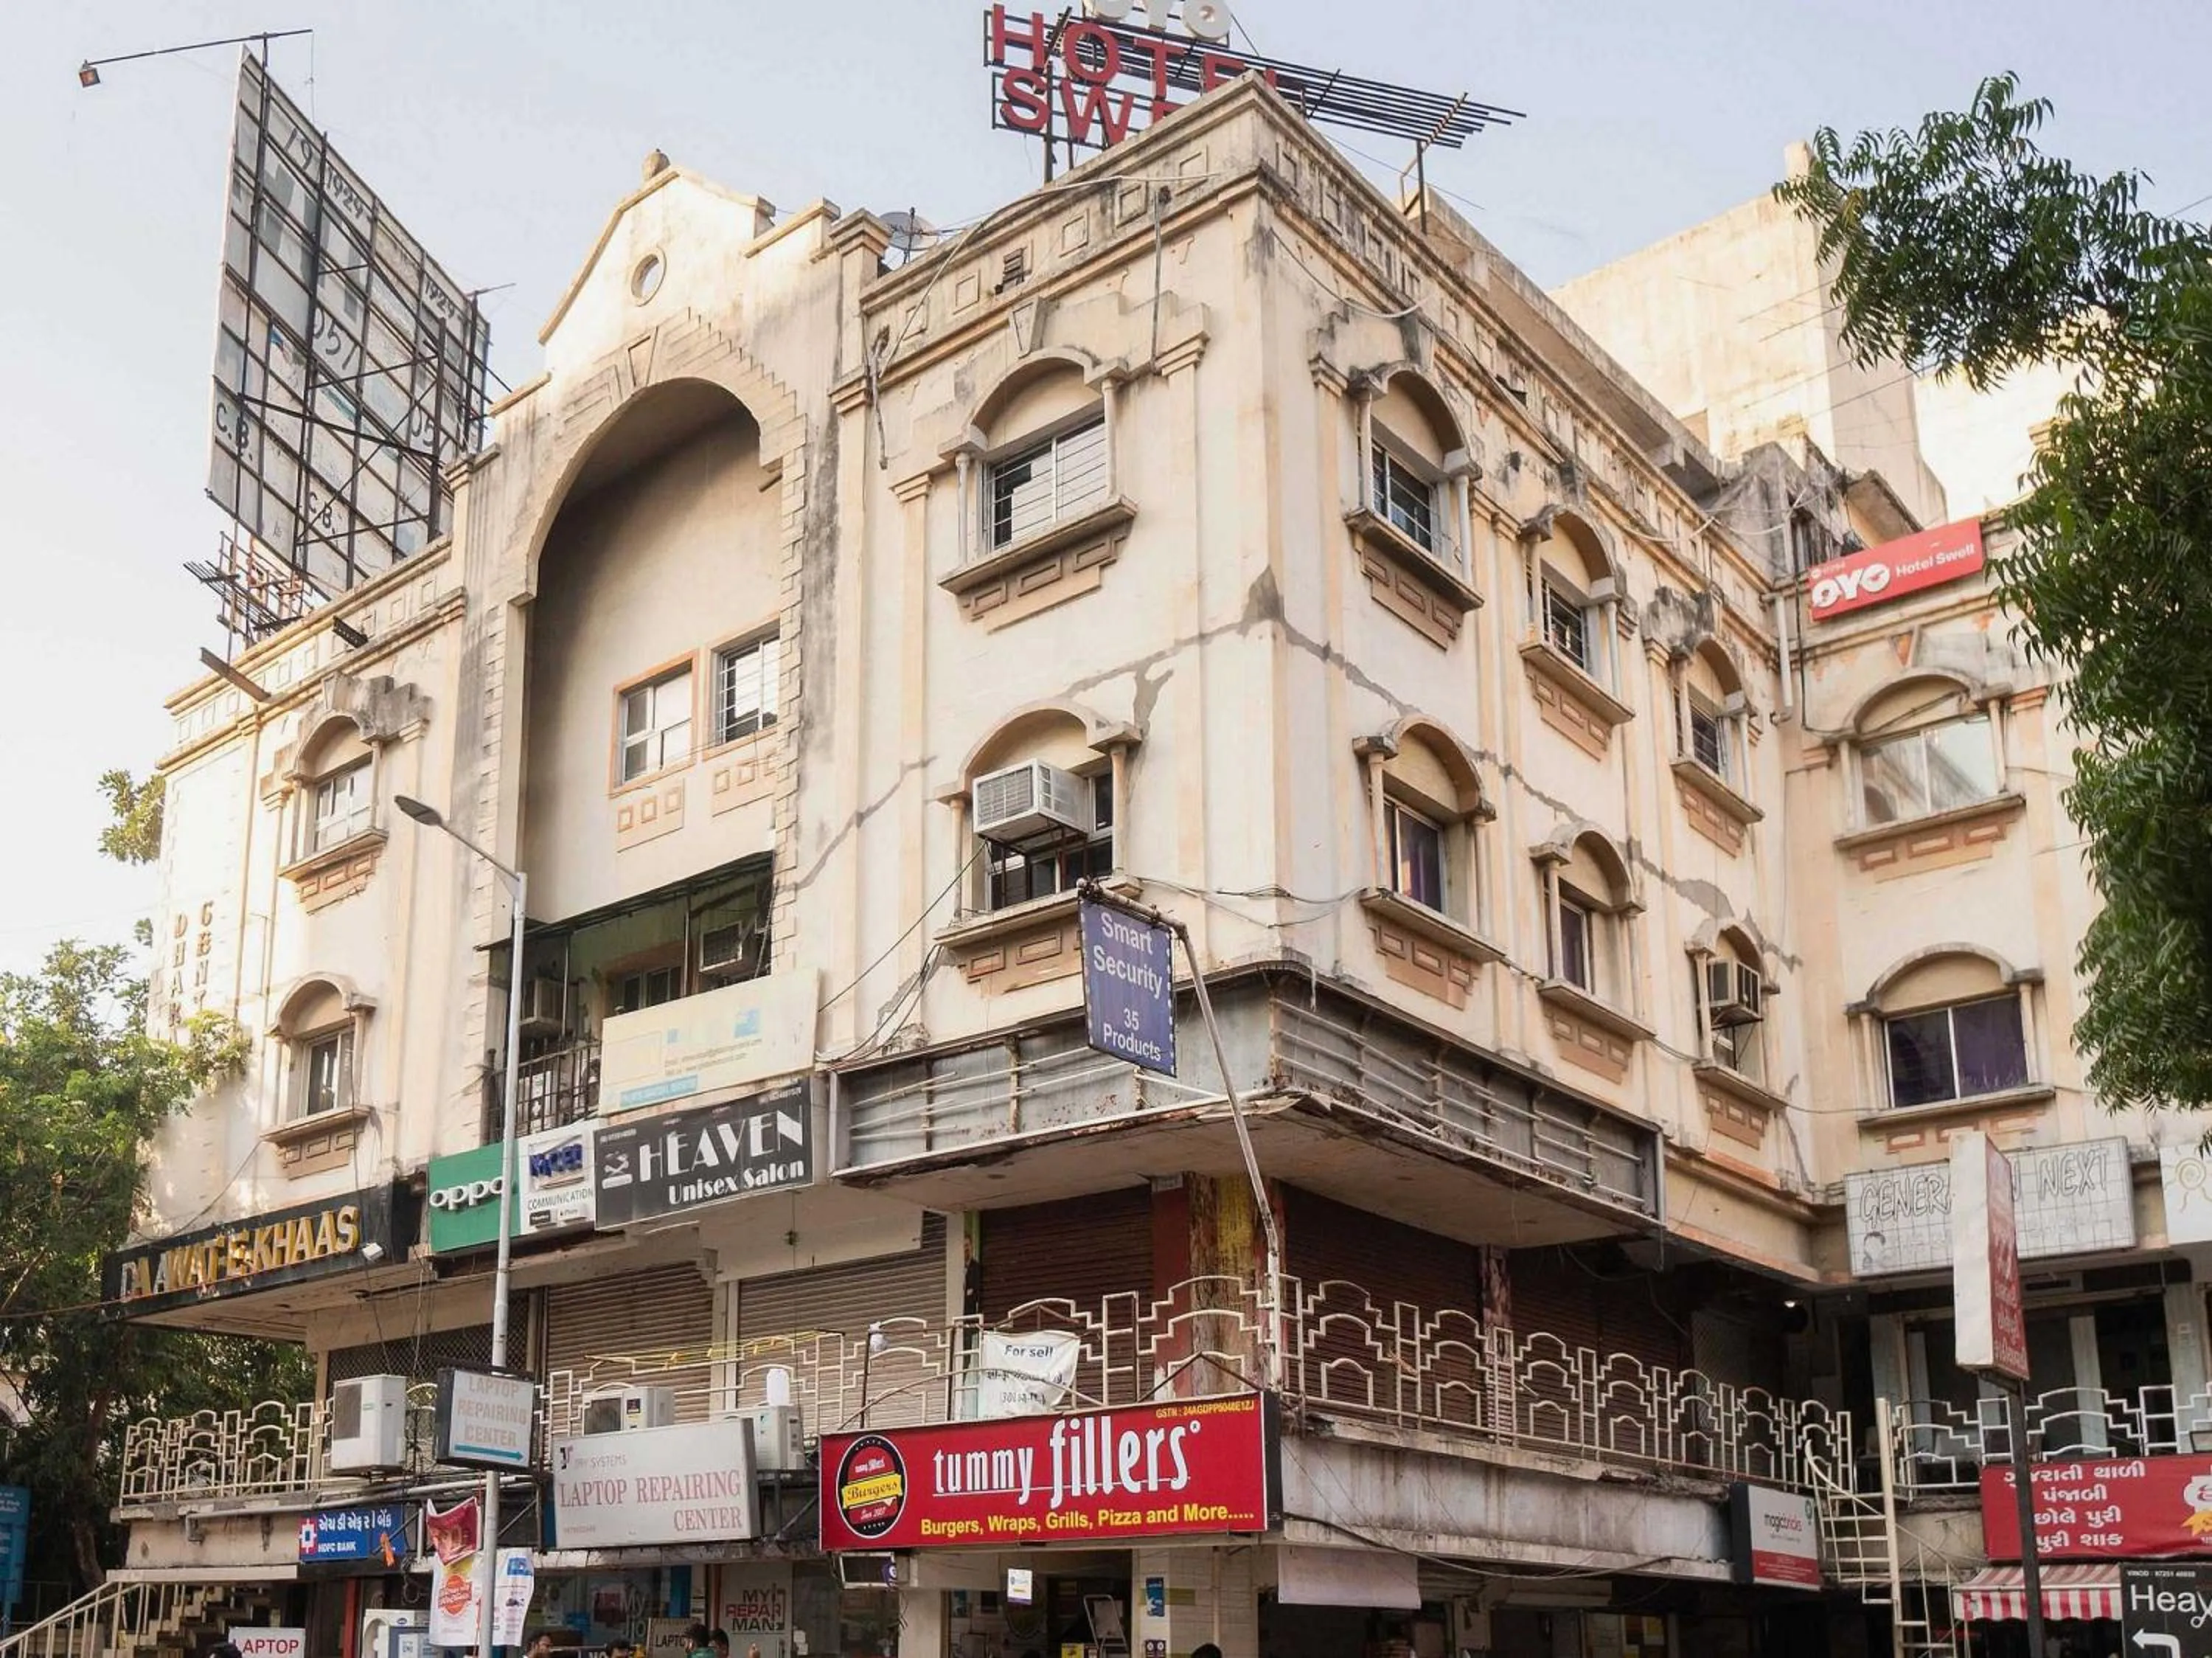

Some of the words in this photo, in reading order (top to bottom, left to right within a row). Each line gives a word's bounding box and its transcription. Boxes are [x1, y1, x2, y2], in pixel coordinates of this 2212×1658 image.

[1812, 563, 1891, 608] OYO
[1896, 557, 1933, 577] Hotel
[1101, 912, 1152, 954] Smart
[1093, 945, 1163, 1000] Security
[1123, 1007, 1140, 1031] 35
[1104, 1023, 1162, 1061] Products
[639, 1105, 804, 1183] HEAVEN
[669, 1176, 740, 1205] Unisex
[742, 1159, 805, 1190] Salon
[2038, 1148, 2107, 1202] NEXT
[429, 1176, 504, 1211] oppo
[1004, 1345, 1025, 1357] For
[1029, 1345, 1053, 1358] sell
[468, 1376, 520, 1398] LAPTOP
[457, 1398, 528, 1425] REPAIRING
[465, 1424, 517, 1447] CENTER
[933, 1448, 1034, 1505] tummy
[1048, 1415, 1192, 1509] fillers
[560, 1478, 627, 1508] LAPTOP
[636, 1469, 740, 1504] REPAIRING
[847, 1482, 897, 1501] Burgers
[674, 1506, 742, 1531] CENTER
[921, 1519, 984, 1538] Burgers,
[989, 1515, 1040, 1536] Wraps,
[1046, 1512, 1093, 1531] Grills,
[1098, 1509, 1142, 1526] Pizza
[1147, 1508, 1180, 1524] and
[742, 1589, 771, 1603] MY
[732, 1617, 773, 1631] MAN
